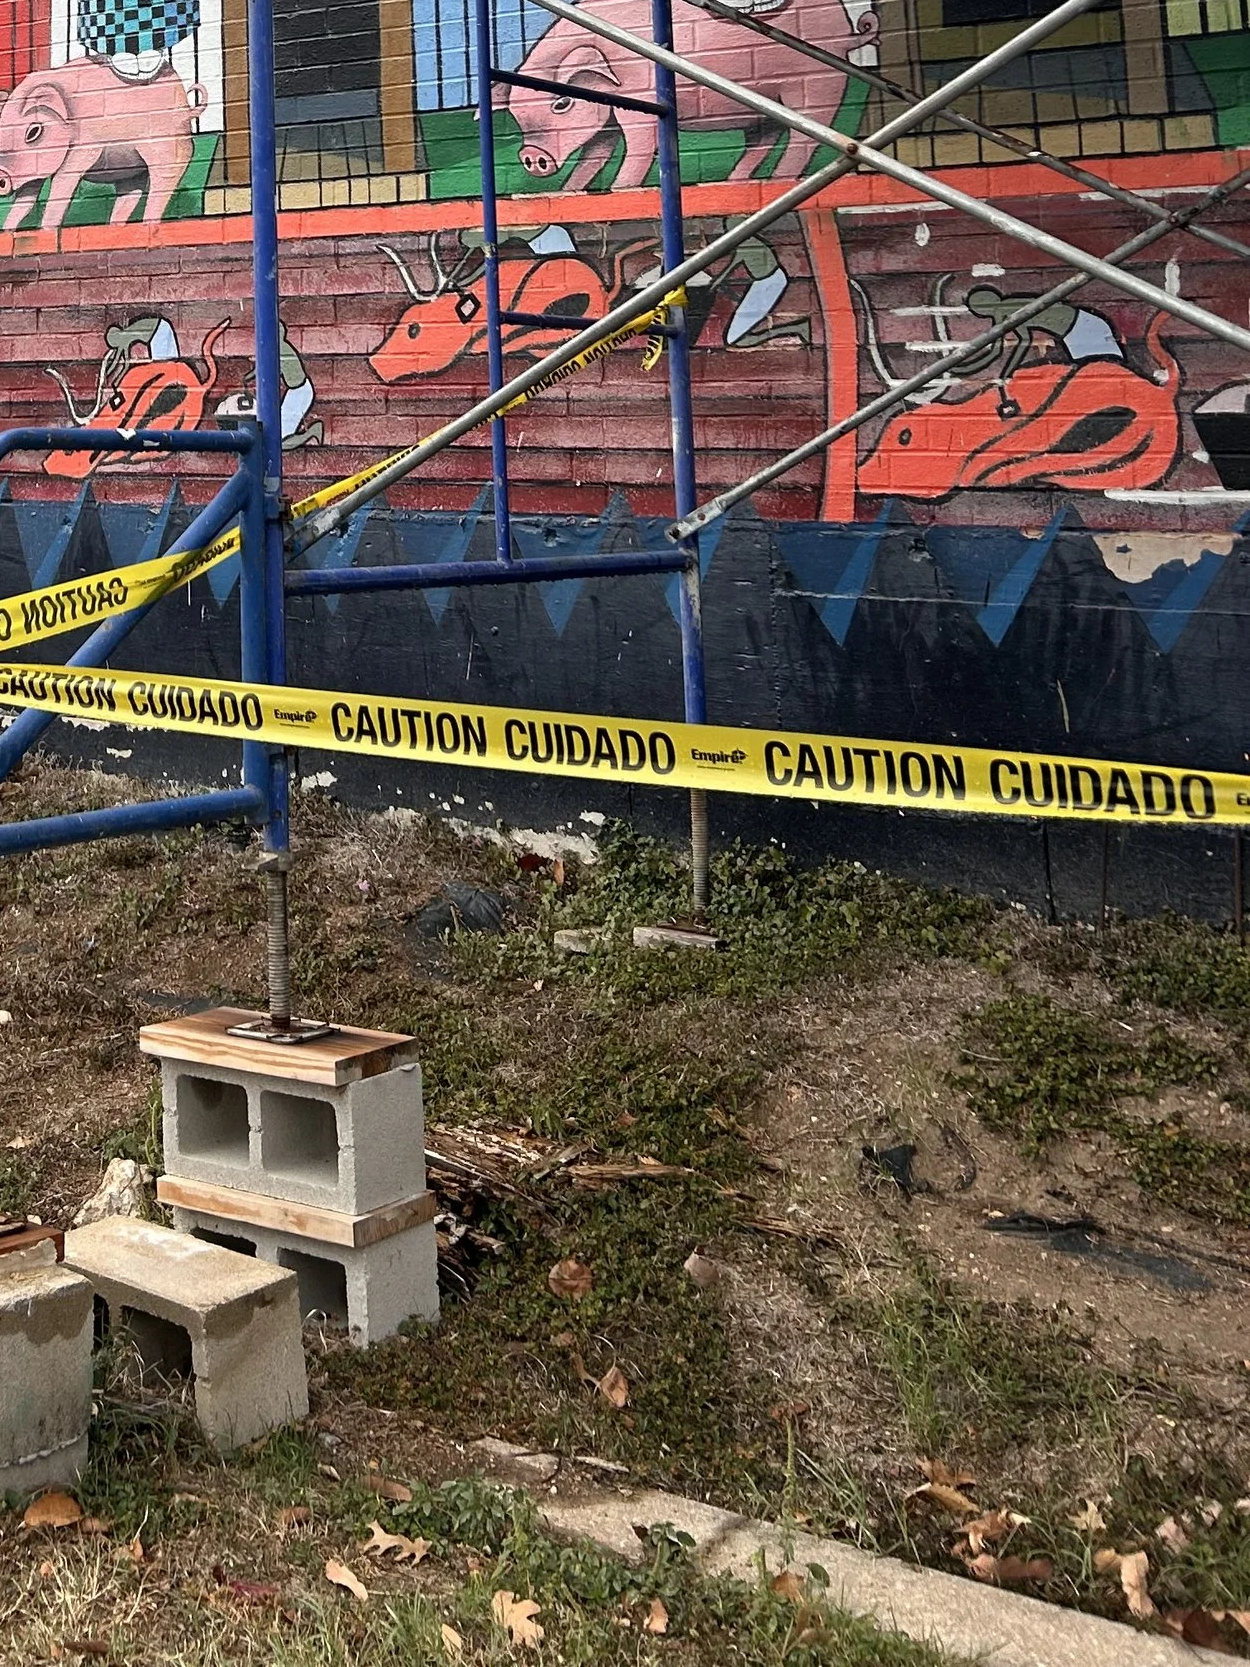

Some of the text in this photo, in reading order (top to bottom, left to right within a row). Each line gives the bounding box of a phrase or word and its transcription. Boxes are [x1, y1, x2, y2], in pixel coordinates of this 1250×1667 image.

[130, 681, 263, 731] CUIDADO
[332, 702, 487, 757] CAUTION
[505, 718, 675, 775] CUIDADO
[691, 748, 748, 764] Empire
[764, 740, 966, 801] CAUTION
[990, 759, 1215, 820] CUIDADO
